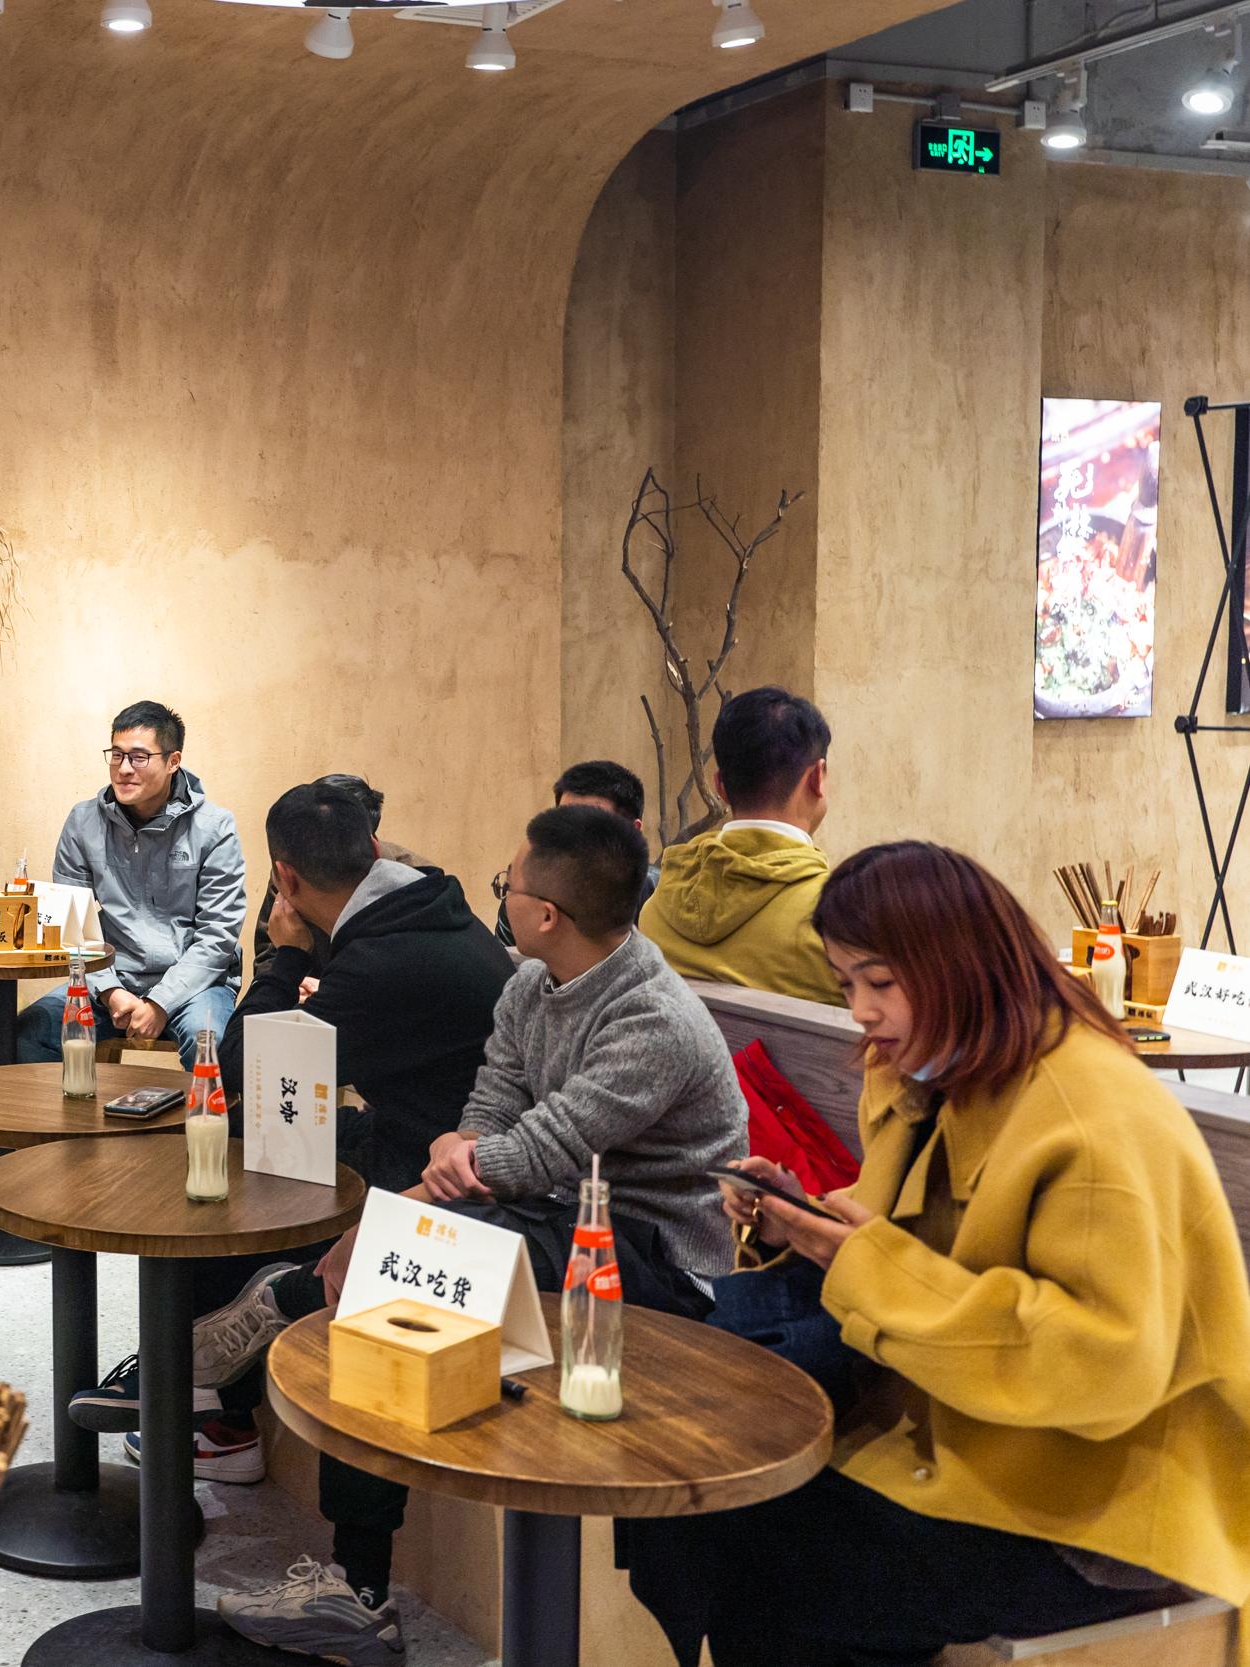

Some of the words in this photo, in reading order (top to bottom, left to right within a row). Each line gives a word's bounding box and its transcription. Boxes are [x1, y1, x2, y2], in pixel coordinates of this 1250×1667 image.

[1184, 981, 1250, 1007] 武汉好吃
[279, 1077, 298, 1125] 汉咖
[379, 1251, 472, 1308] 武汉吃货
